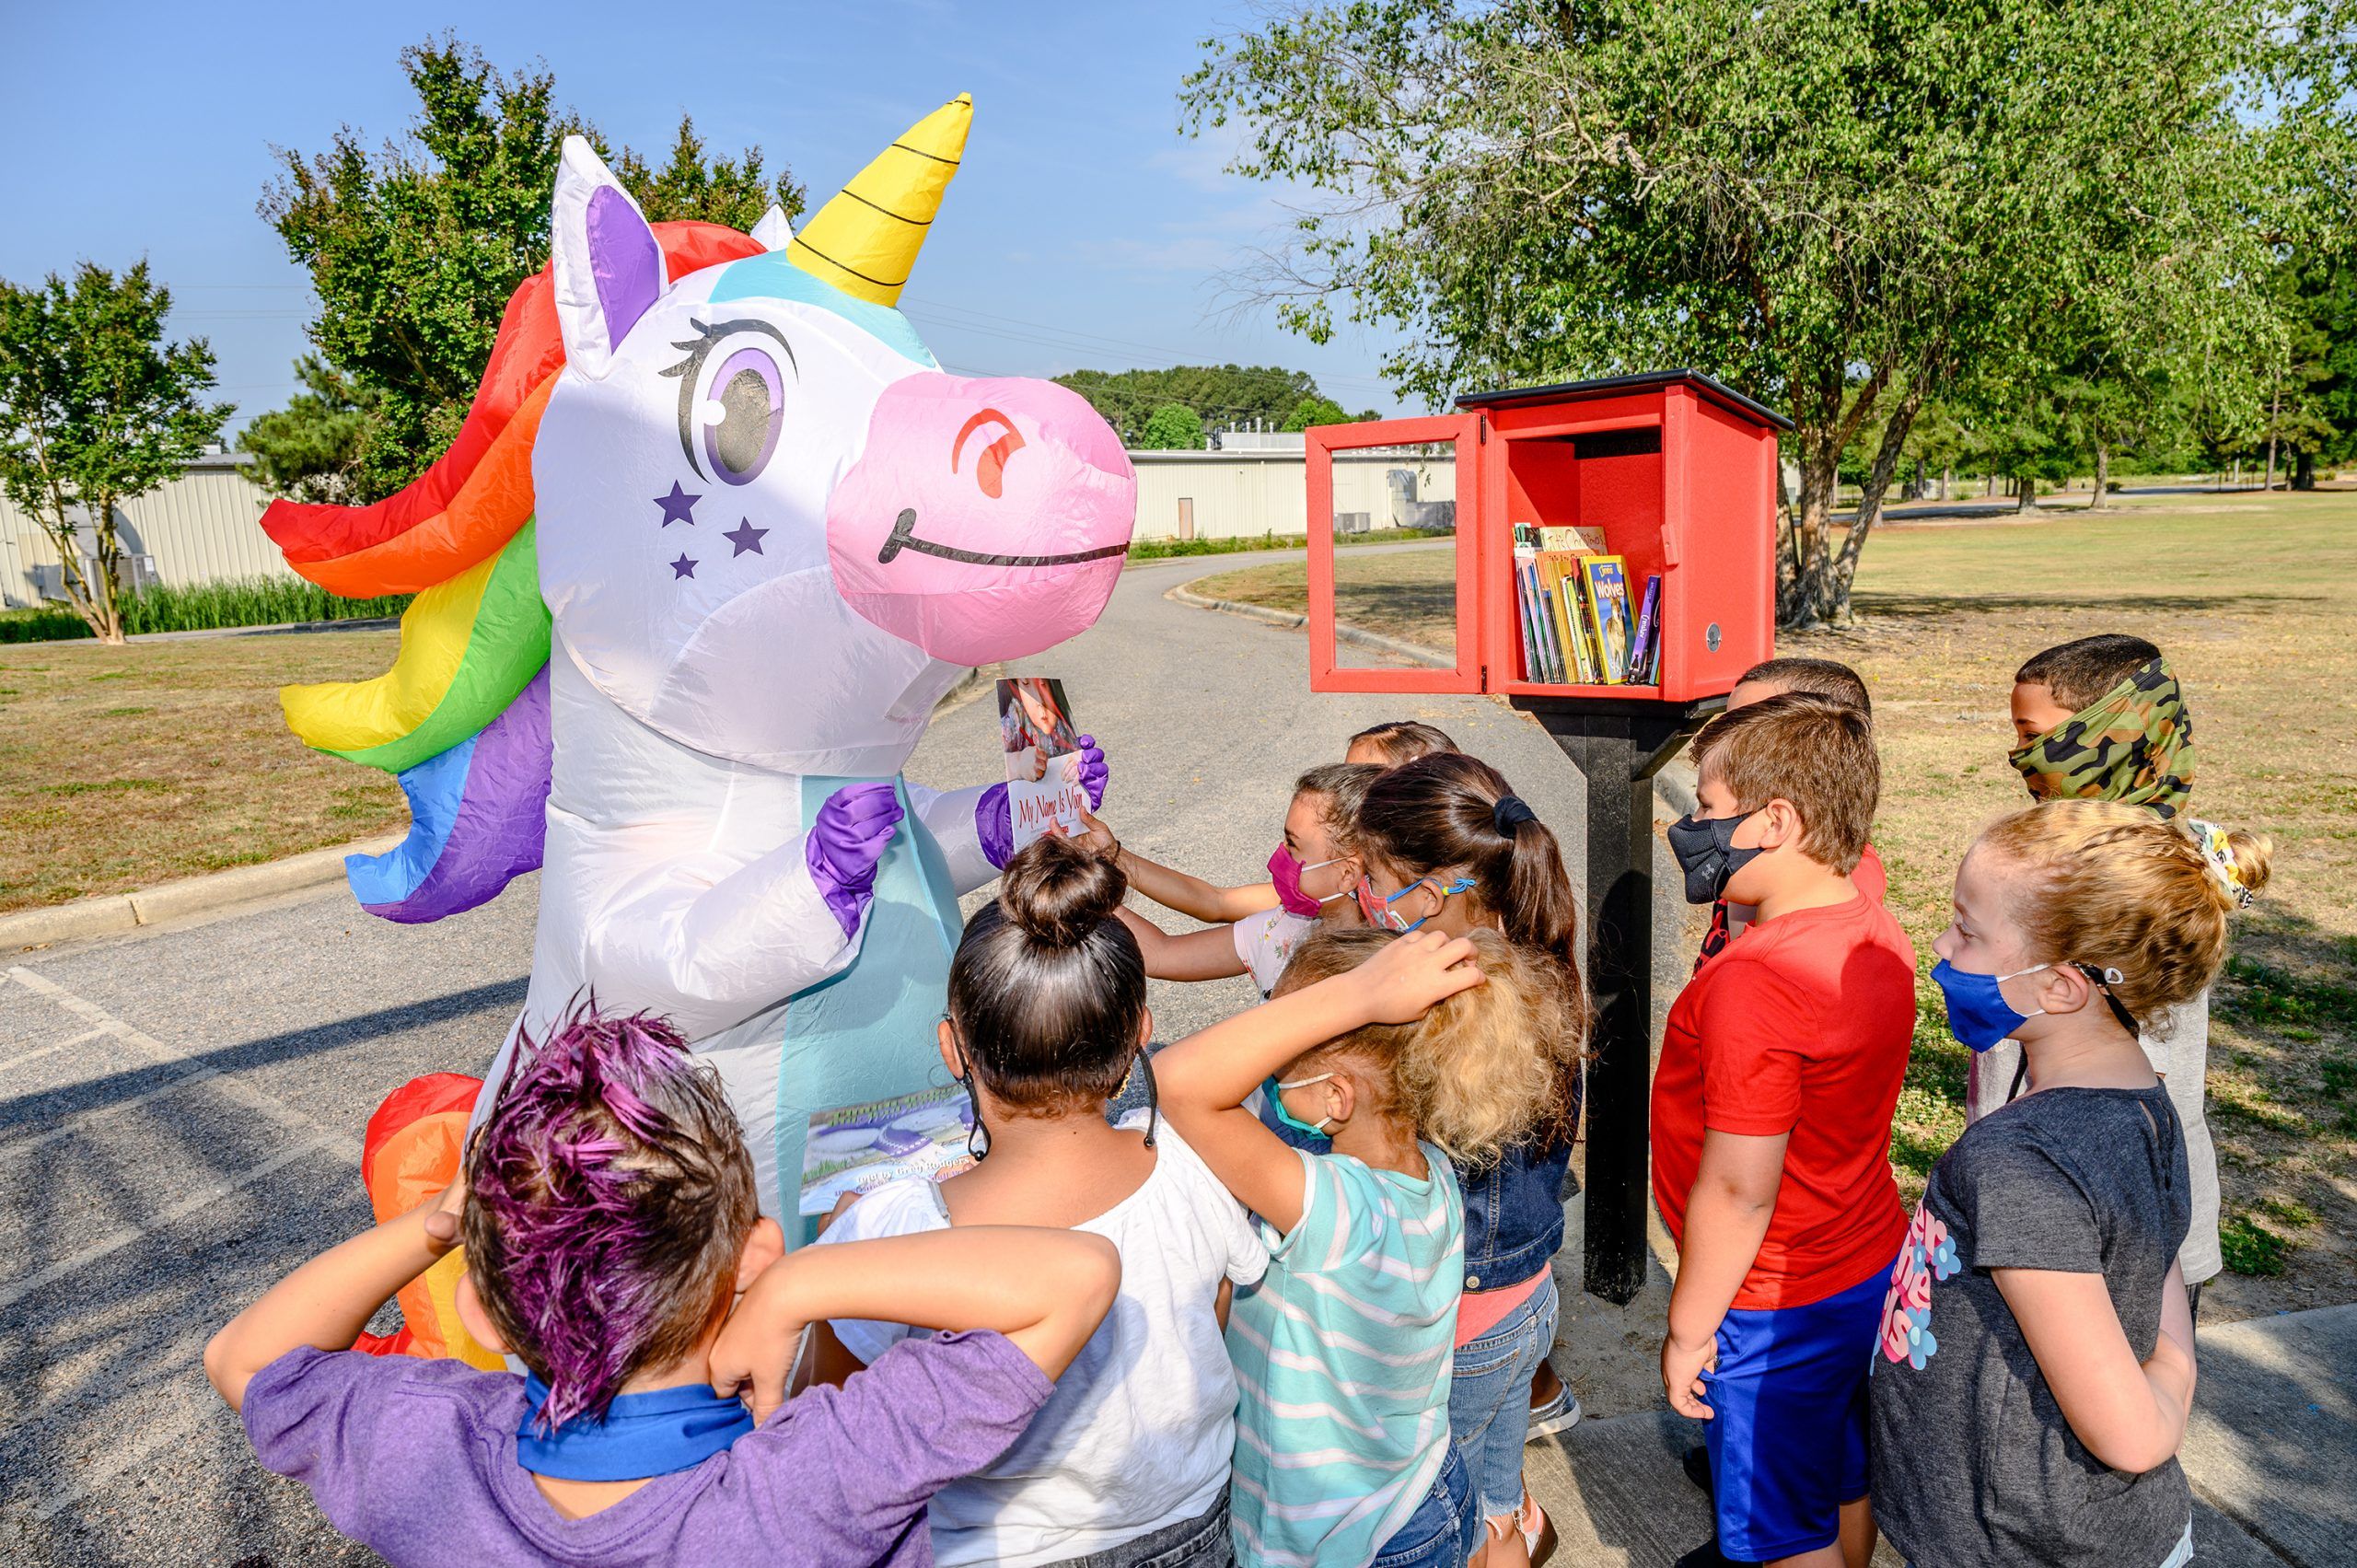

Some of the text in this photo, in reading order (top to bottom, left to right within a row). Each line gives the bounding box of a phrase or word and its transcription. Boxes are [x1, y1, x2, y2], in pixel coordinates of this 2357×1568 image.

[1595, 578, 1625, 598] Wolves
[1019, 785, 1083, 829] My Name Is Yoon
[880, 1170, 893, 1181] by
[896, 1164, 923, 1175] Greg
[926, 1156, 970, 1170] Rodgers
[1893, 1231, 1932, 1309] he
[1882, 1286, 1914, 1359] ls
